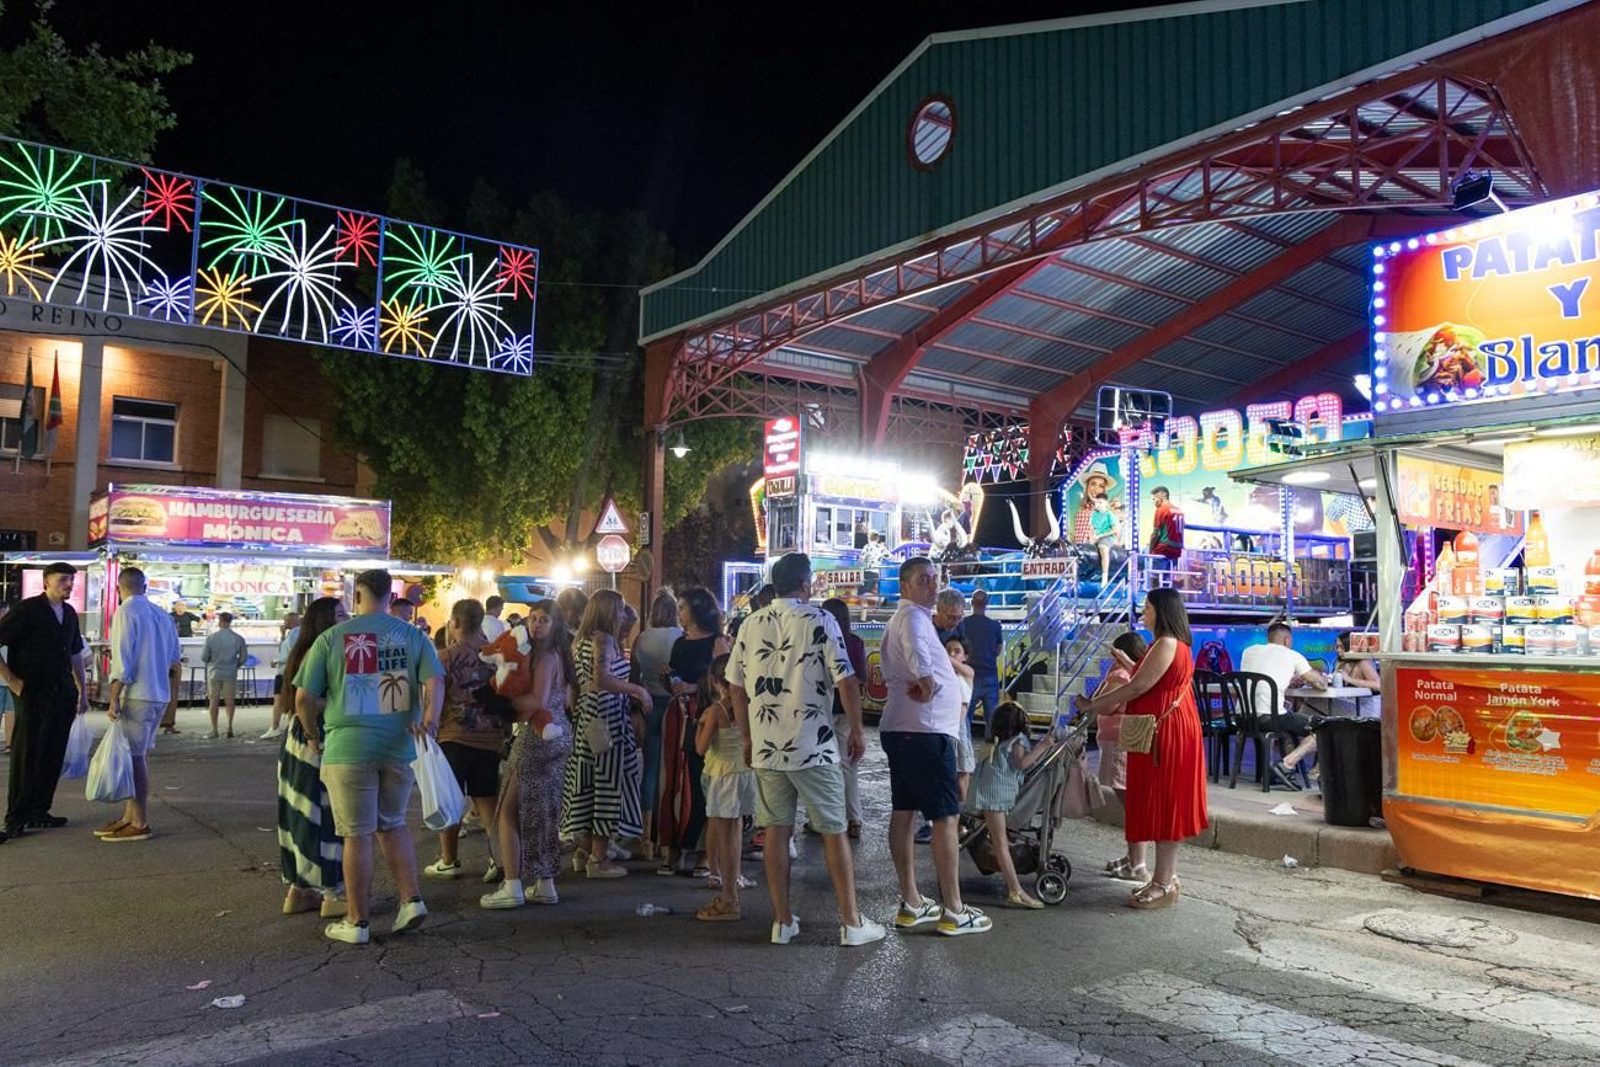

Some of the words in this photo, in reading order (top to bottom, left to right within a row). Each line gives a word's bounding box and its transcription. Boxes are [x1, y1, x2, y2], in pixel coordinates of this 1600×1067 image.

[1547, 276, 1591, 319] Y
[31, 304, 123, 331] REINO
[1479, 334, 1600, 387] Blan
[168, 501, 336, 525] HAMBURGUESERÍA
[827, 571, 861, 583] SALIDA
[378, 647, 408, 658] REAL
[378, 658, 407, 671] LIFE
[1417, 679, 1455, 690] Patata
[1500, 683, 1542, 694] Patata
[1414, 690, 1457, 701] Normal
[1530, 696, 1560, 707] York
